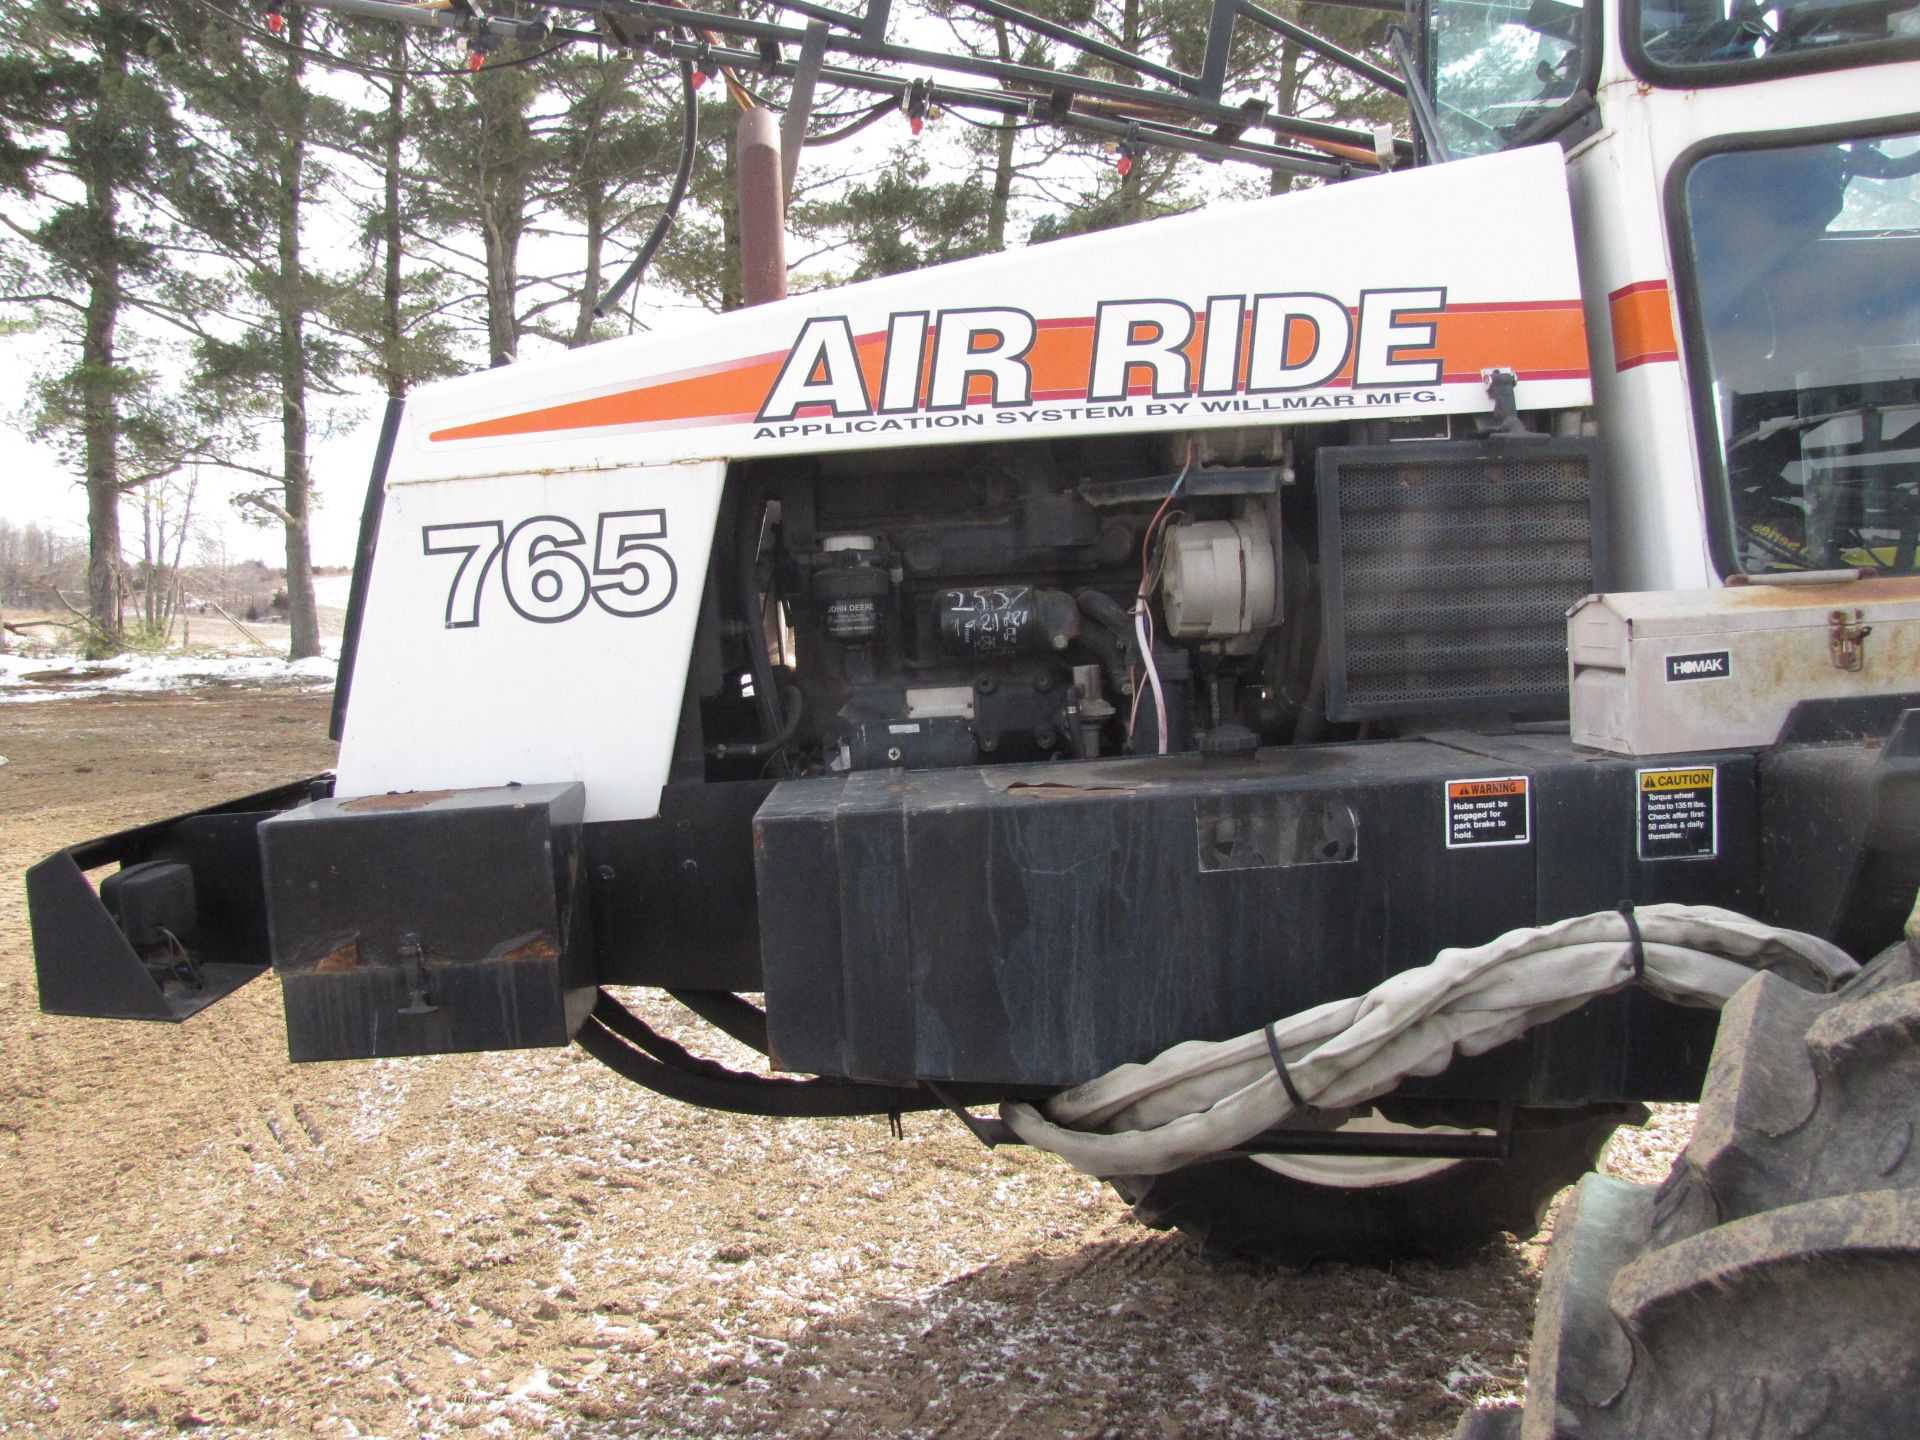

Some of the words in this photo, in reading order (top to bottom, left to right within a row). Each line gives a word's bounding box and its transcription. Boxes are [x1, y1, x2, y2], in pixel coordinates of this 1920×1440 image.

[753, 306, 1038, 425] AIR
[1086, 286, 1448, 404] RIDE
[753, 414, 984, 440] APPLICATION
[996, 405, 1134, 424] SYSTEM
[1146, 402, 1190, 416] BY
[1201, 395, 1355, 413] WILLMAR
[1366, 390, 1445, 405] MFG.
[422, 508, 678, 630] 765
[827, 605, 848, 614] JOHN
[849, 603, 876, 612] DEERE
[1672, 658, 1724, 675] HOMAK
[1657, 773, 1710, 787] CAUTION
[1471, 782, 1517, 794] WARNING
[1648, 793, 1672, 802] Torque
[1673, 791, 1695, 799] wheel
[1453, 802, 1474, 810] Hubs
[1476, 801, 1496, 809] must
[1498, 800, 1508, 808] be
[1453, 811, 1488, 821] engaged
[1489, 810, 1502, 818] for
[1648, 813, 1671, 821] Check
[1690, 810, 1705, 818] first
[1454, 822, 1472, 831] park
[1473, 820, 1496, 828] brake
[1679, 821, 1685, 829] &
[1687, 821, 1705, 829] daily
[1454, 831, 1475, 839] hold.
[1648, 832, 1683, 840] thereafter.
